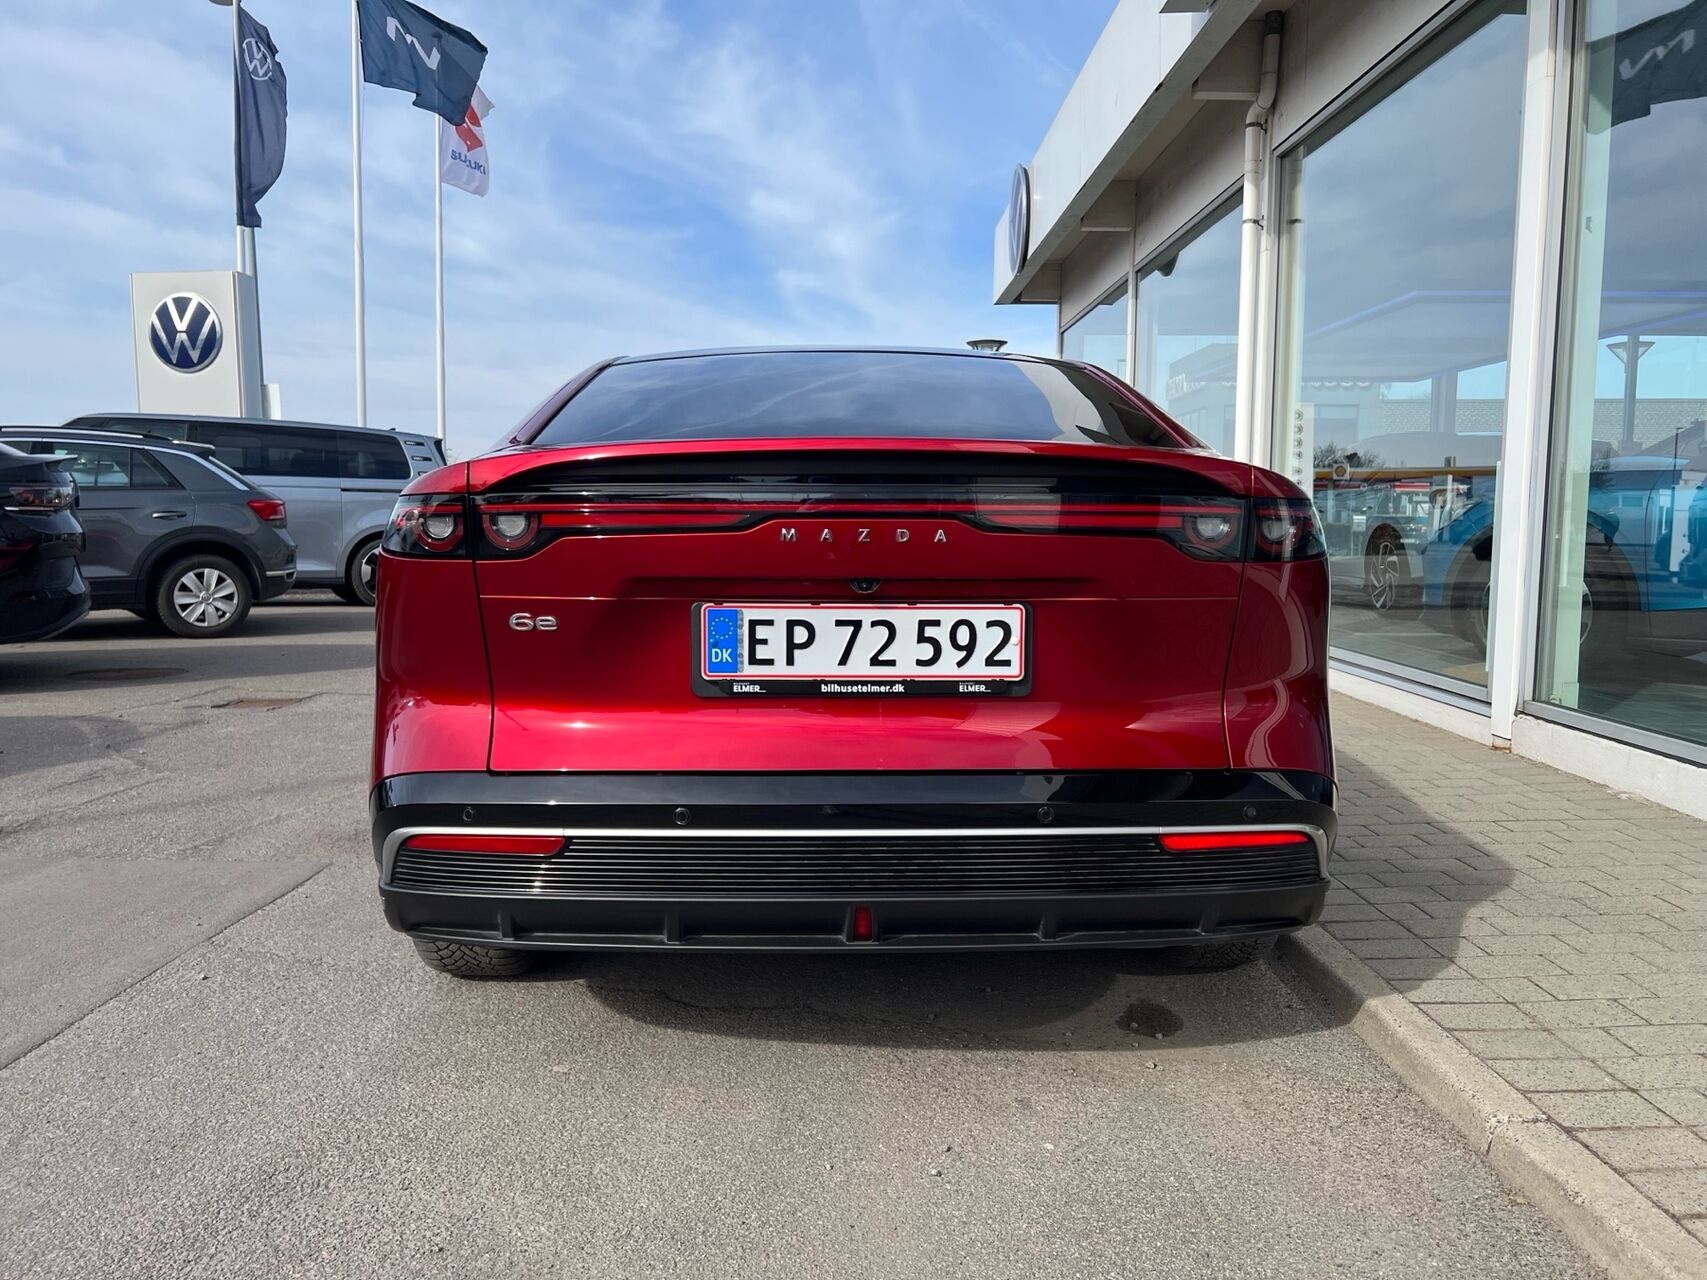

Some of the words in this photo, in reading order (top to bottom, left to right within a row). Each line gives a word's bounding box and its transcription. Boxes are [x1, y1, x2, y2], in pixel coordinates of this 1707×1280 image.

[149, 293, 221, 370] VW
[780, 528, 947, 542] MAZDA
[509, 612, 557, 631] 6e
[748, 619, 816, 666] EP
[835, 619, 897, 667] 72
[915, 619, 1012, 668] 592
[711, 648, 733, 663] DK
[820, 683, 905, 693] bilhusetelmer.dk
